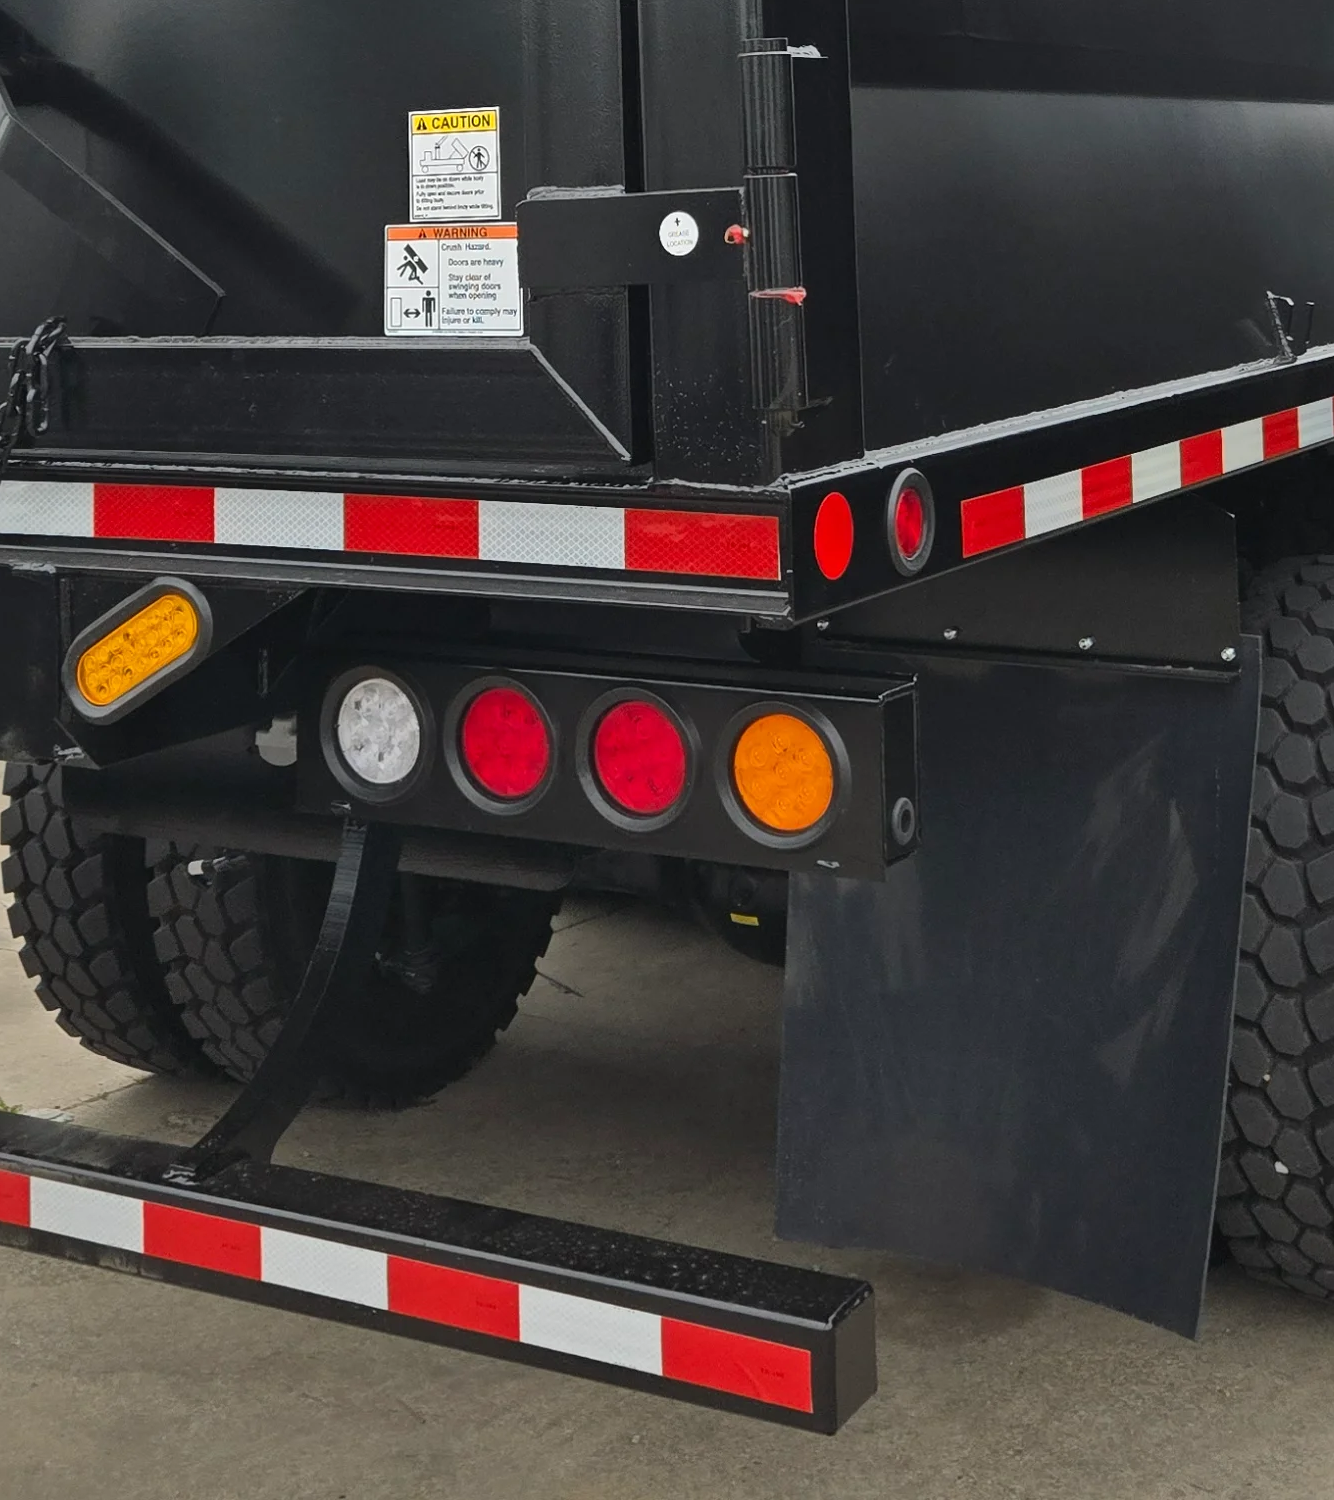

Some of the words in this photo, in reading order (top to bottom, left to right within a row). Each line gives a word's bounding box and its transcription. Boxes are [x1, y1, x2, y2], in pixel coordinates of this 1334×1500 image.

[432, 114, 490, 129] CAUTION
[433, 227, 487, 238] WARNING
[483, 258, 504, 267] heavy
[448, 273, 463, 282] Stay
[484, 273, 491, 281] of
[448, 283, 479, 292] swinging
[481, 282, 501, 290] doors
[468, 293, 497, 301] opening
[475, 308, 501, 316] comply
[503, 309, 518, 317] may
